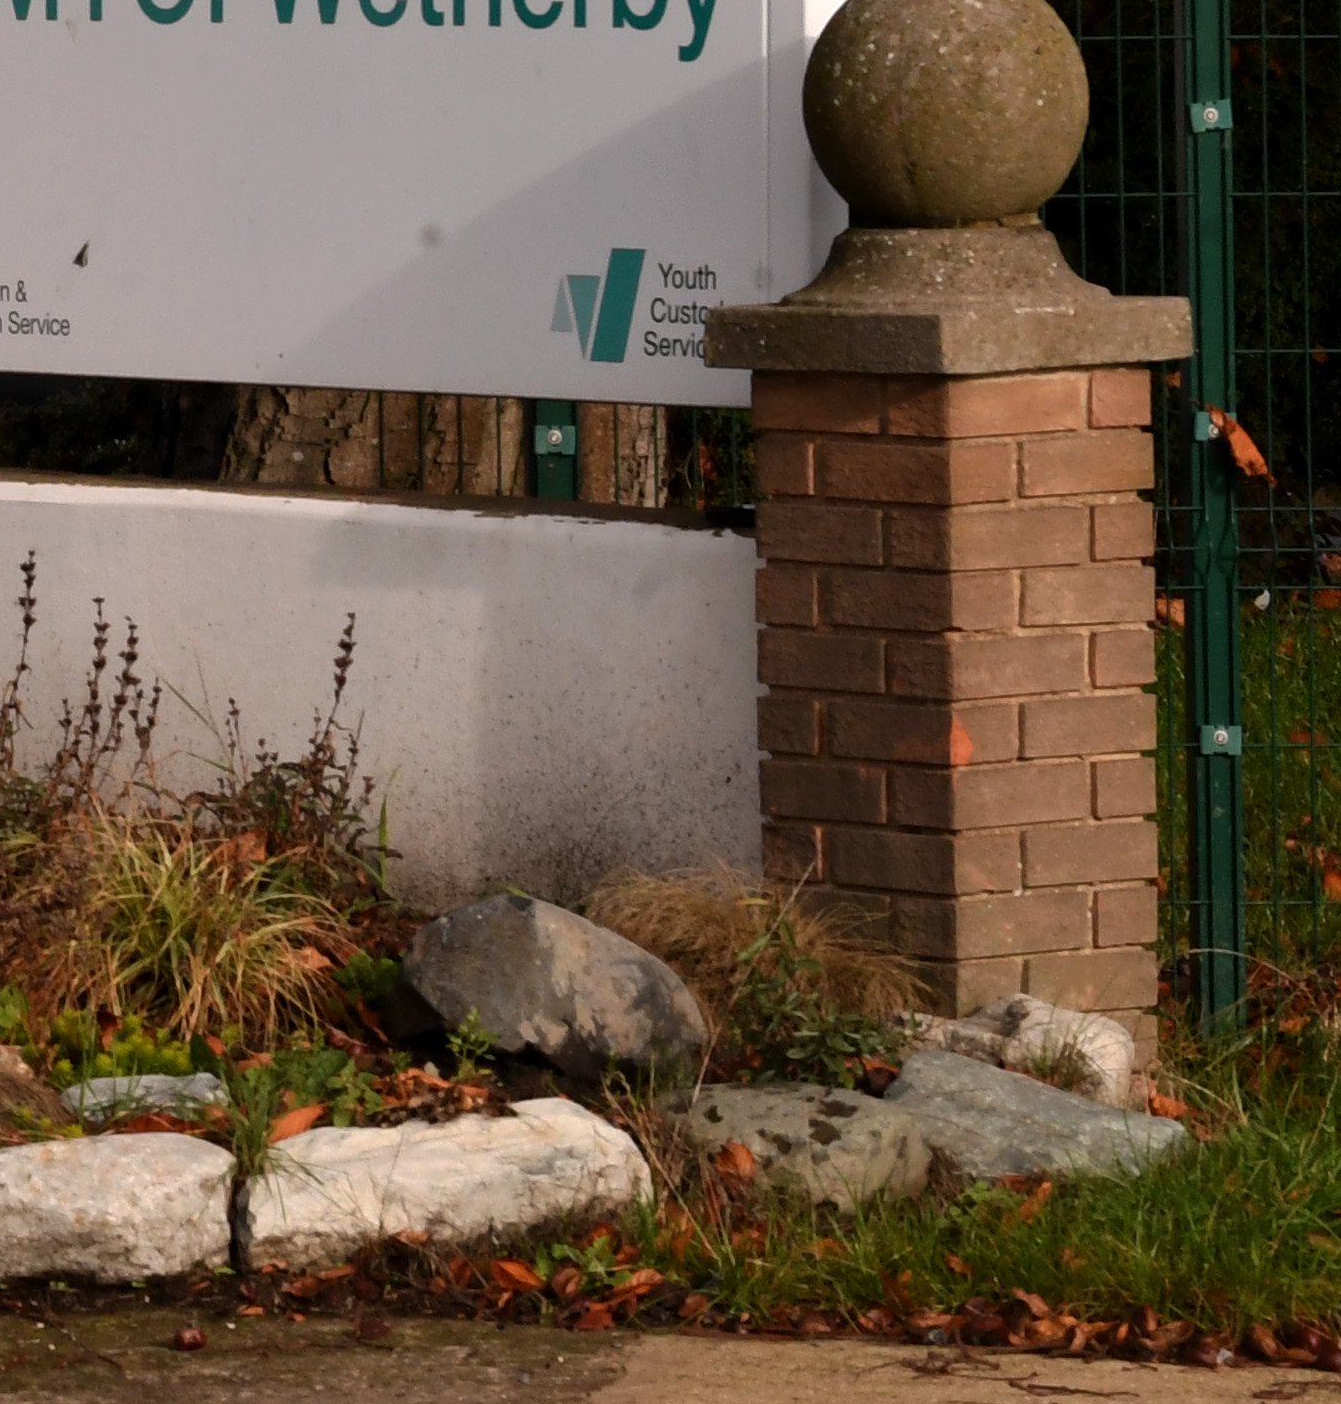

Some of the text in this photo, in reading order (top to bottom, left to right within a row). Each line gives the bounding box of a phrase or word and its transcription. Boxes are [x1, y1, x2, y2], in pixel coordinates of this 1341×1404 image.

[658, 262, 717, 290] Youth
[15, 279, 28, 303] &
[7, 310, 71, 337] Service
[650, 297, 717, 325] Custo
[643, 330, 705, 358] Servic
